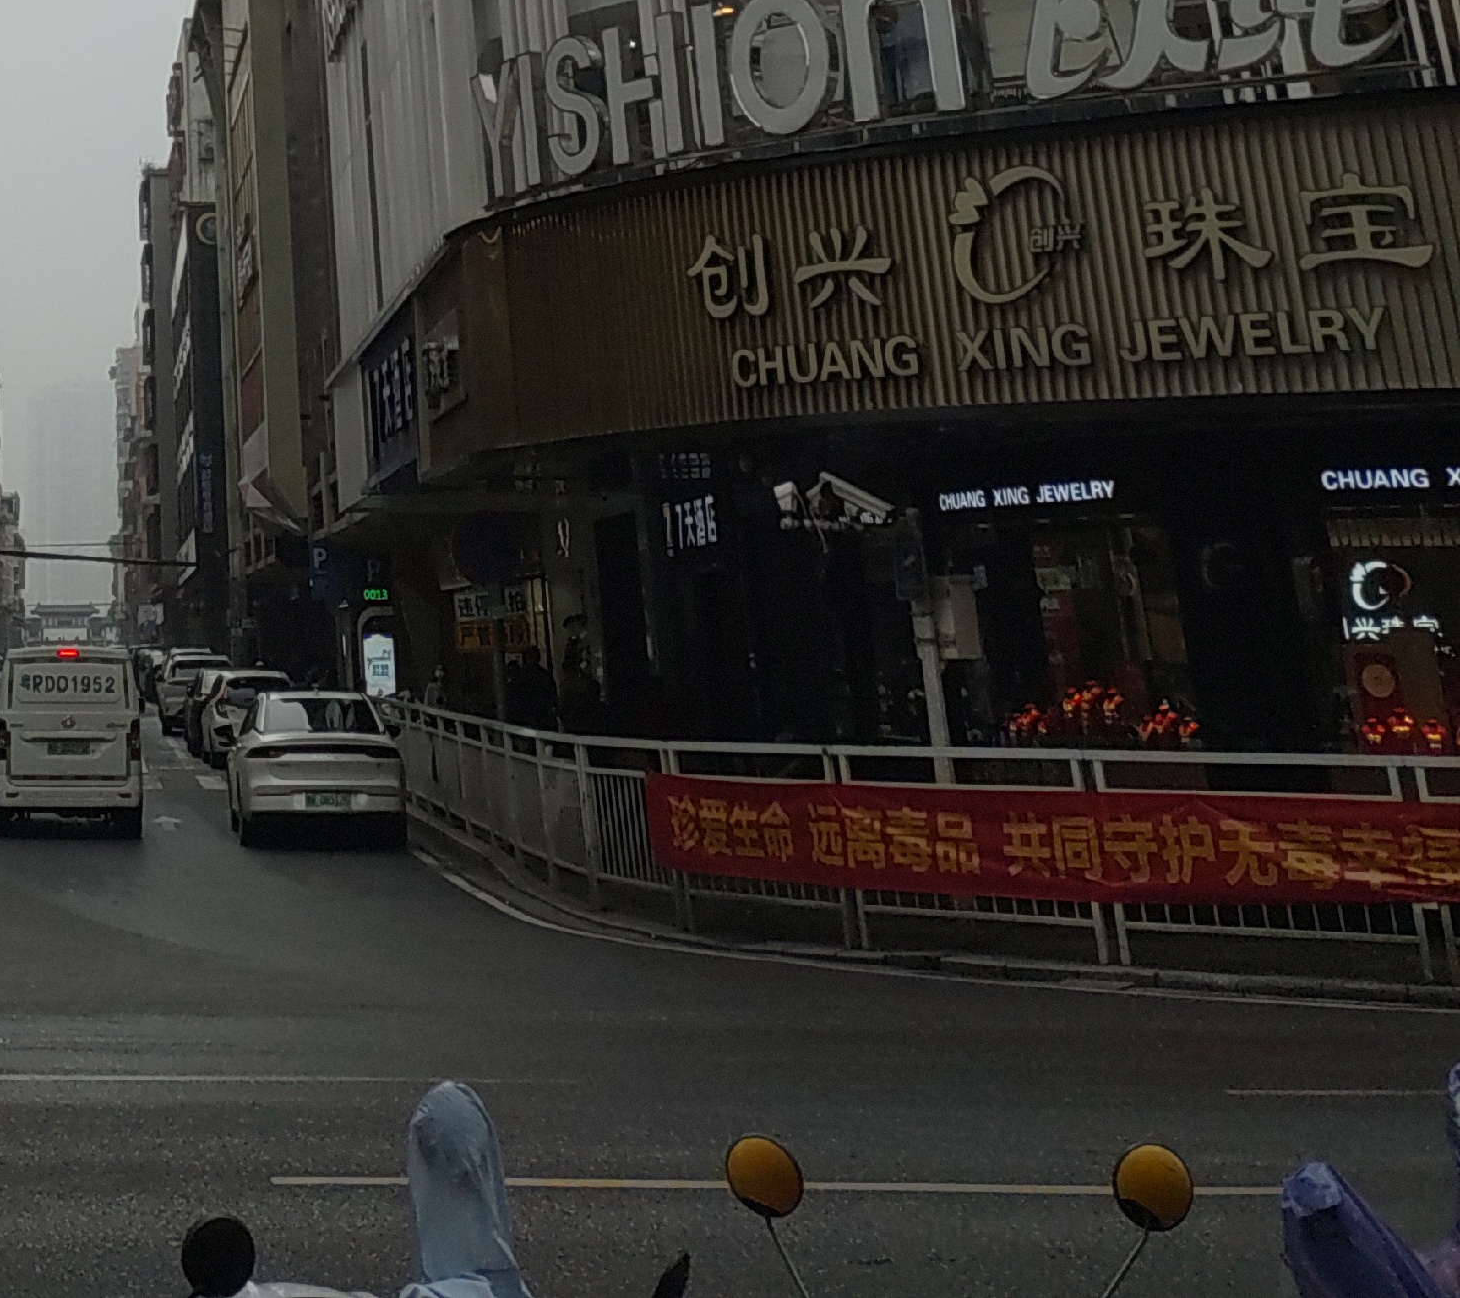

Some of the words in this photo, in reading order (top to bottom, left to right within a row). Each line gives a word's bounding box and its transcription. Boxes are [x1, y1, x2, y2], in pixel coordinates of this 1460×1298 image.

[687, 223, 893, 319] 创兴
[1143, 172, 1434, 281] 珠宝
[732, 334, 920, 389] CHUANG
[956, 321, 1092, 374] XING
[1120, 306, 1386, 365] JEWELRY
[939, 490, 987, 512] CHUANG
[992, 486, 1030, 507] XING
[1036, 480, 1115, 503] JEWELRY
[1321, 468, 1430, 491] CHUANG
[667, 794, 794, 863] 珍爱生命
[807, 803, 981, 874] 远离毒品
